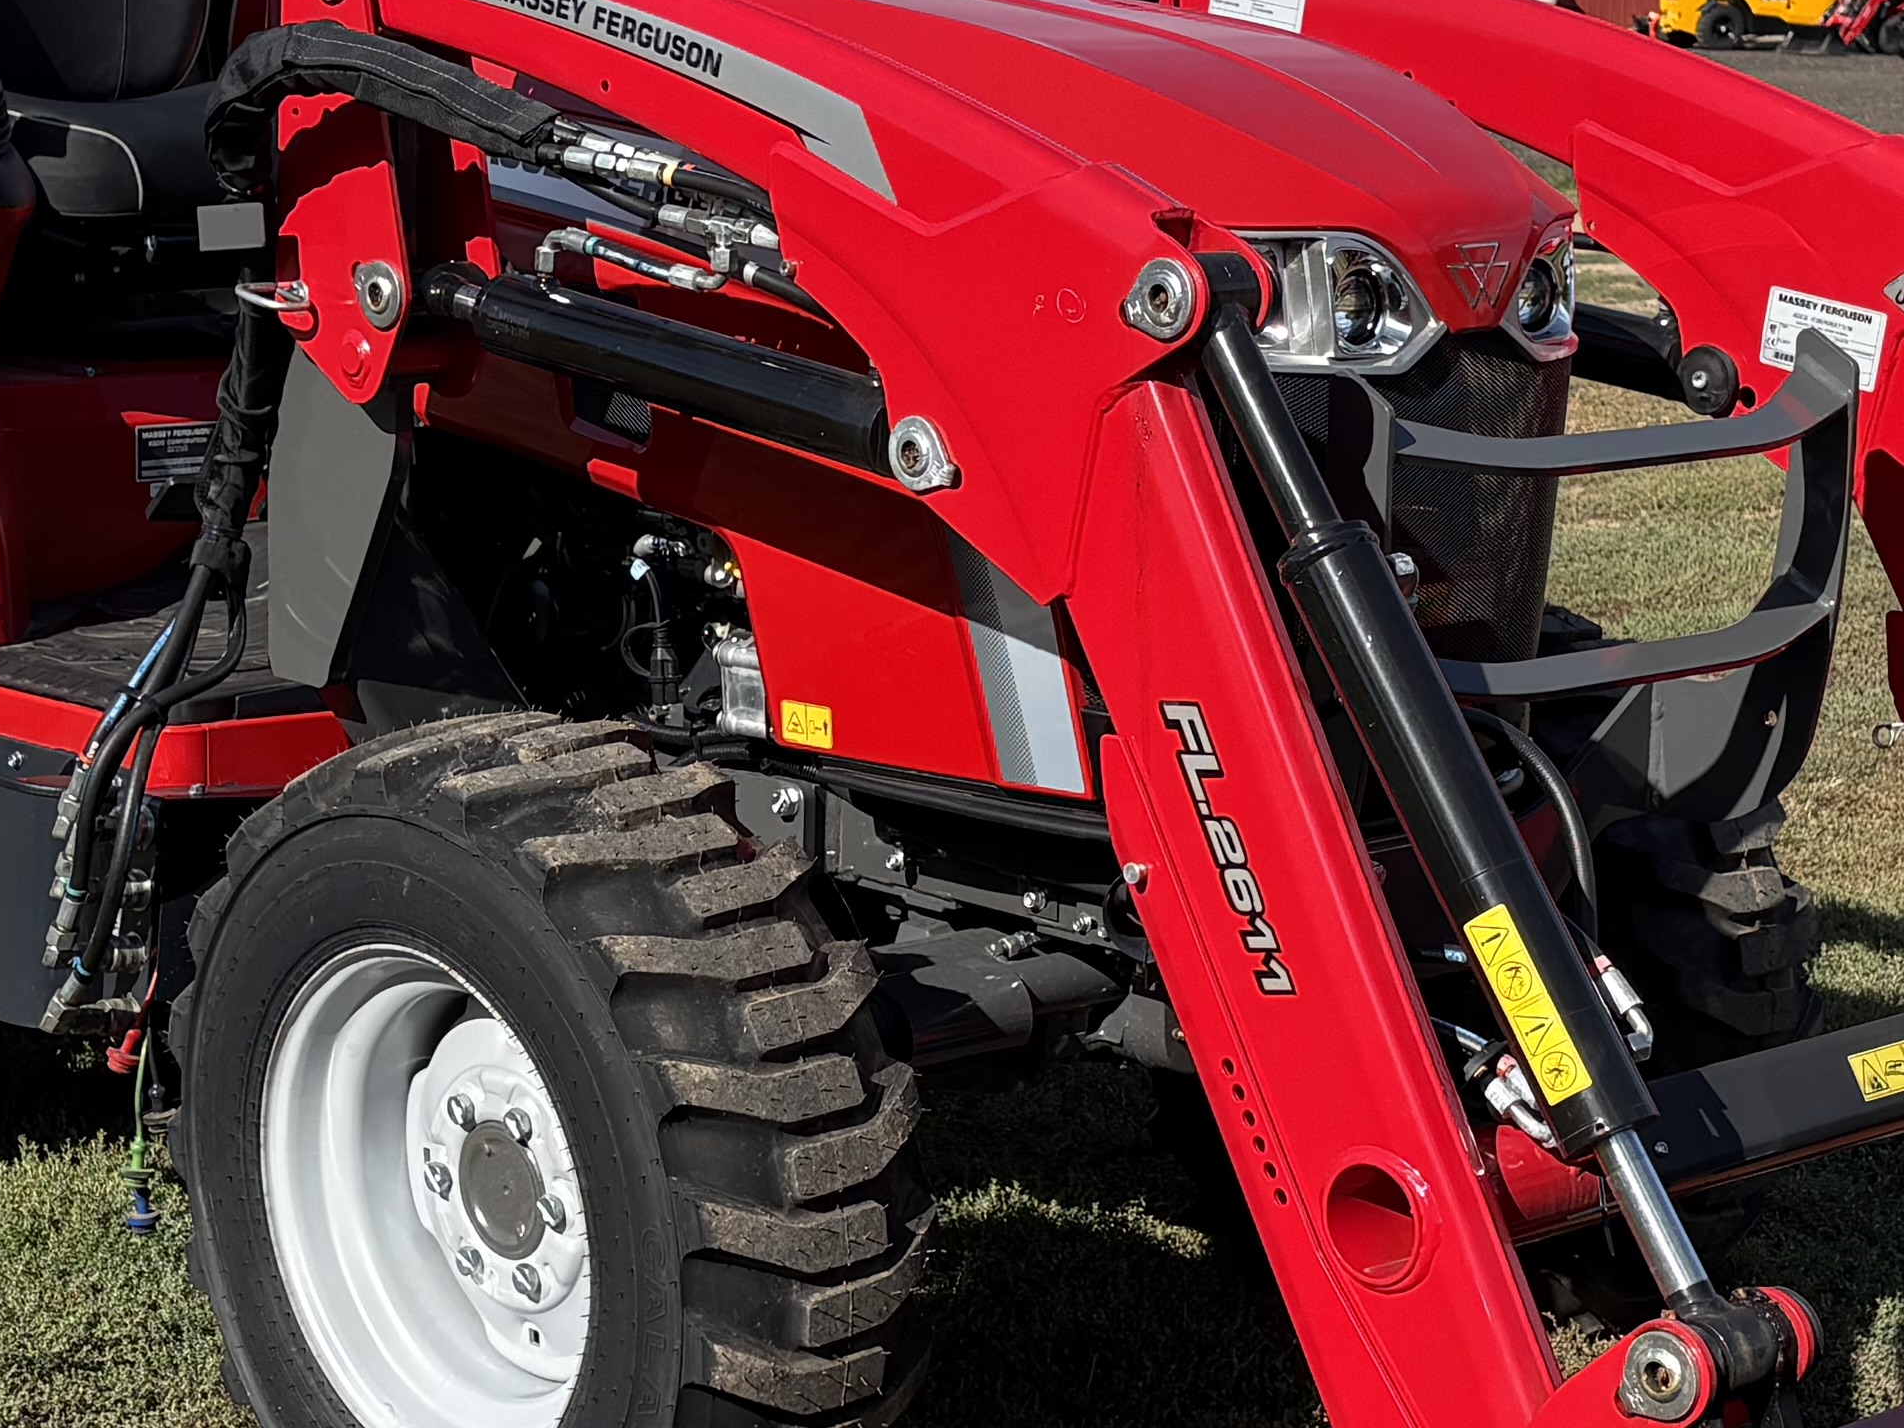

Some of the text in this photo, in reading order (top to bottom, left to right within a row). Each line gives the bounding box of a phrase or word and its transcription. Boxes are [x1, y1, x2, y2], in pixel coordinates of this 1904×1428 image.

[591, 6, 723, 79] FERGUSON
[1778, 293, 1873, 325] MASSEY FERGUSON
[1159, 701, 1298, 996] FL.2611
